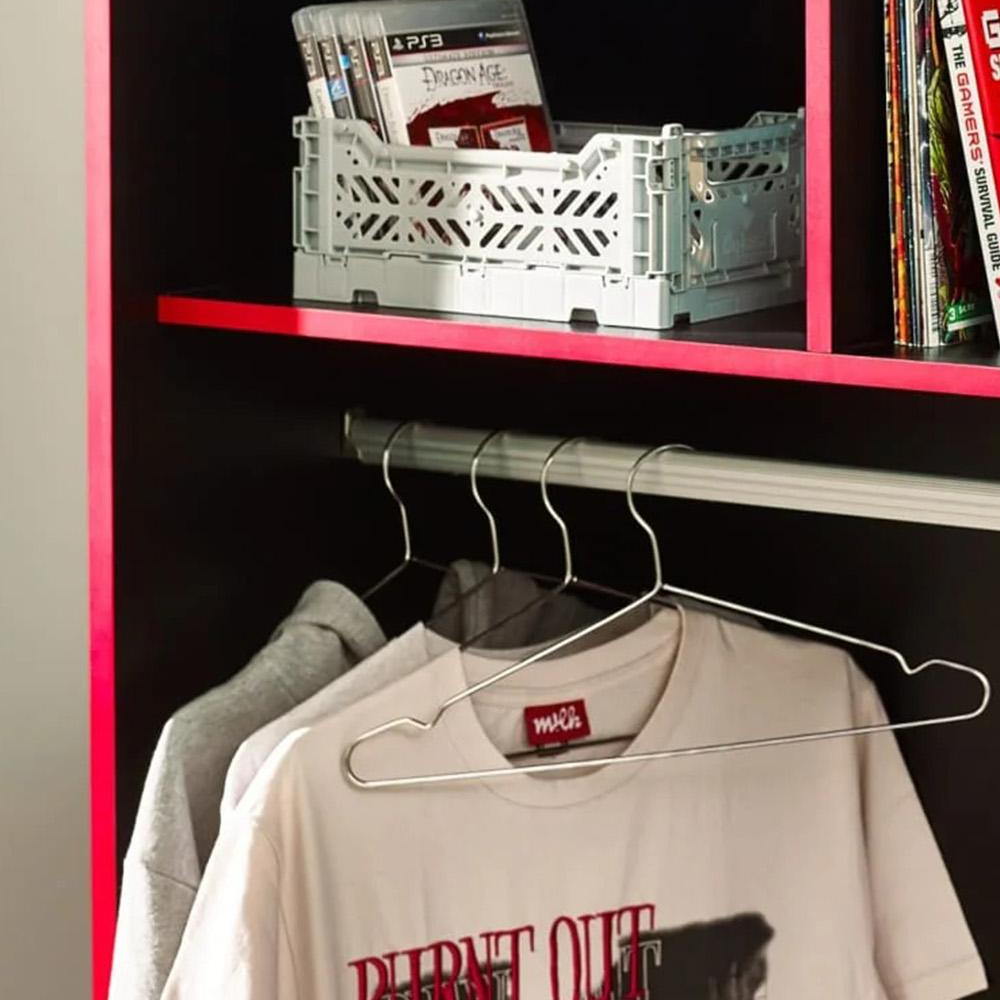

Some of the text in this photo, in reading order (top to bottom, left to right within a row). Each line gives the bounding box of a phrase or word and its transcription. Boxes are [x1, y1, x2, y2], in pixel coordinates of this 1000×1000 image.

[406, 33, 443, 50] PS3
[952, 43, 966, 69] THE
[479, 63, 502, 86] AGE
[956, 72, 983, 164] GAMERS'
[974, 167, 995, 230] SURVIVAL
[532, 705, 582, 734] milk
[549, 903, 655, 1000] OUT
